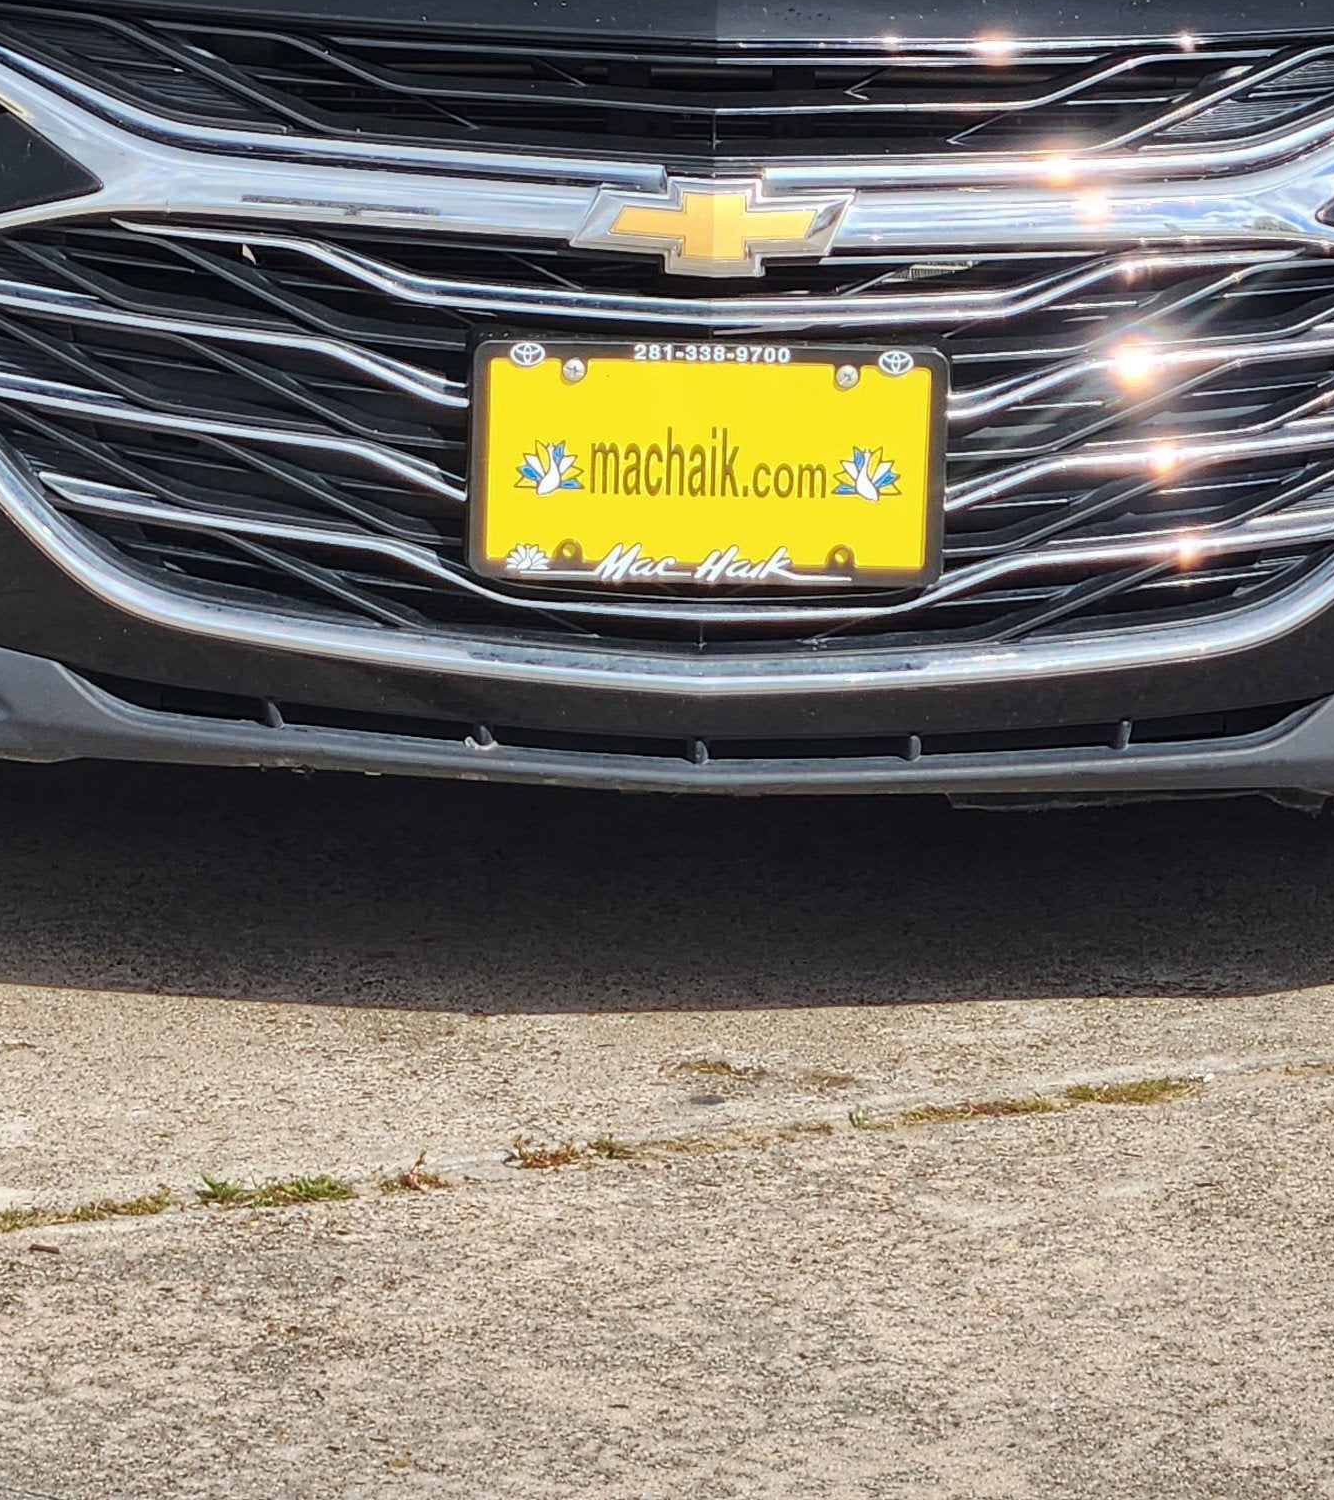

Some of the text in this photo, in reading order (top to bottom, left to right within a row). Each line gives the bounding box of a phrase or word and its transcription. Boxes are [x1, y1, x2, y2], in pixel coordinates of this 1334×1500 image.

[633, 344, 791, 365] 281-338-9700
[590, 426, 827, 499] machaik.com
[593, 542, 805, 582] Mac Haik
